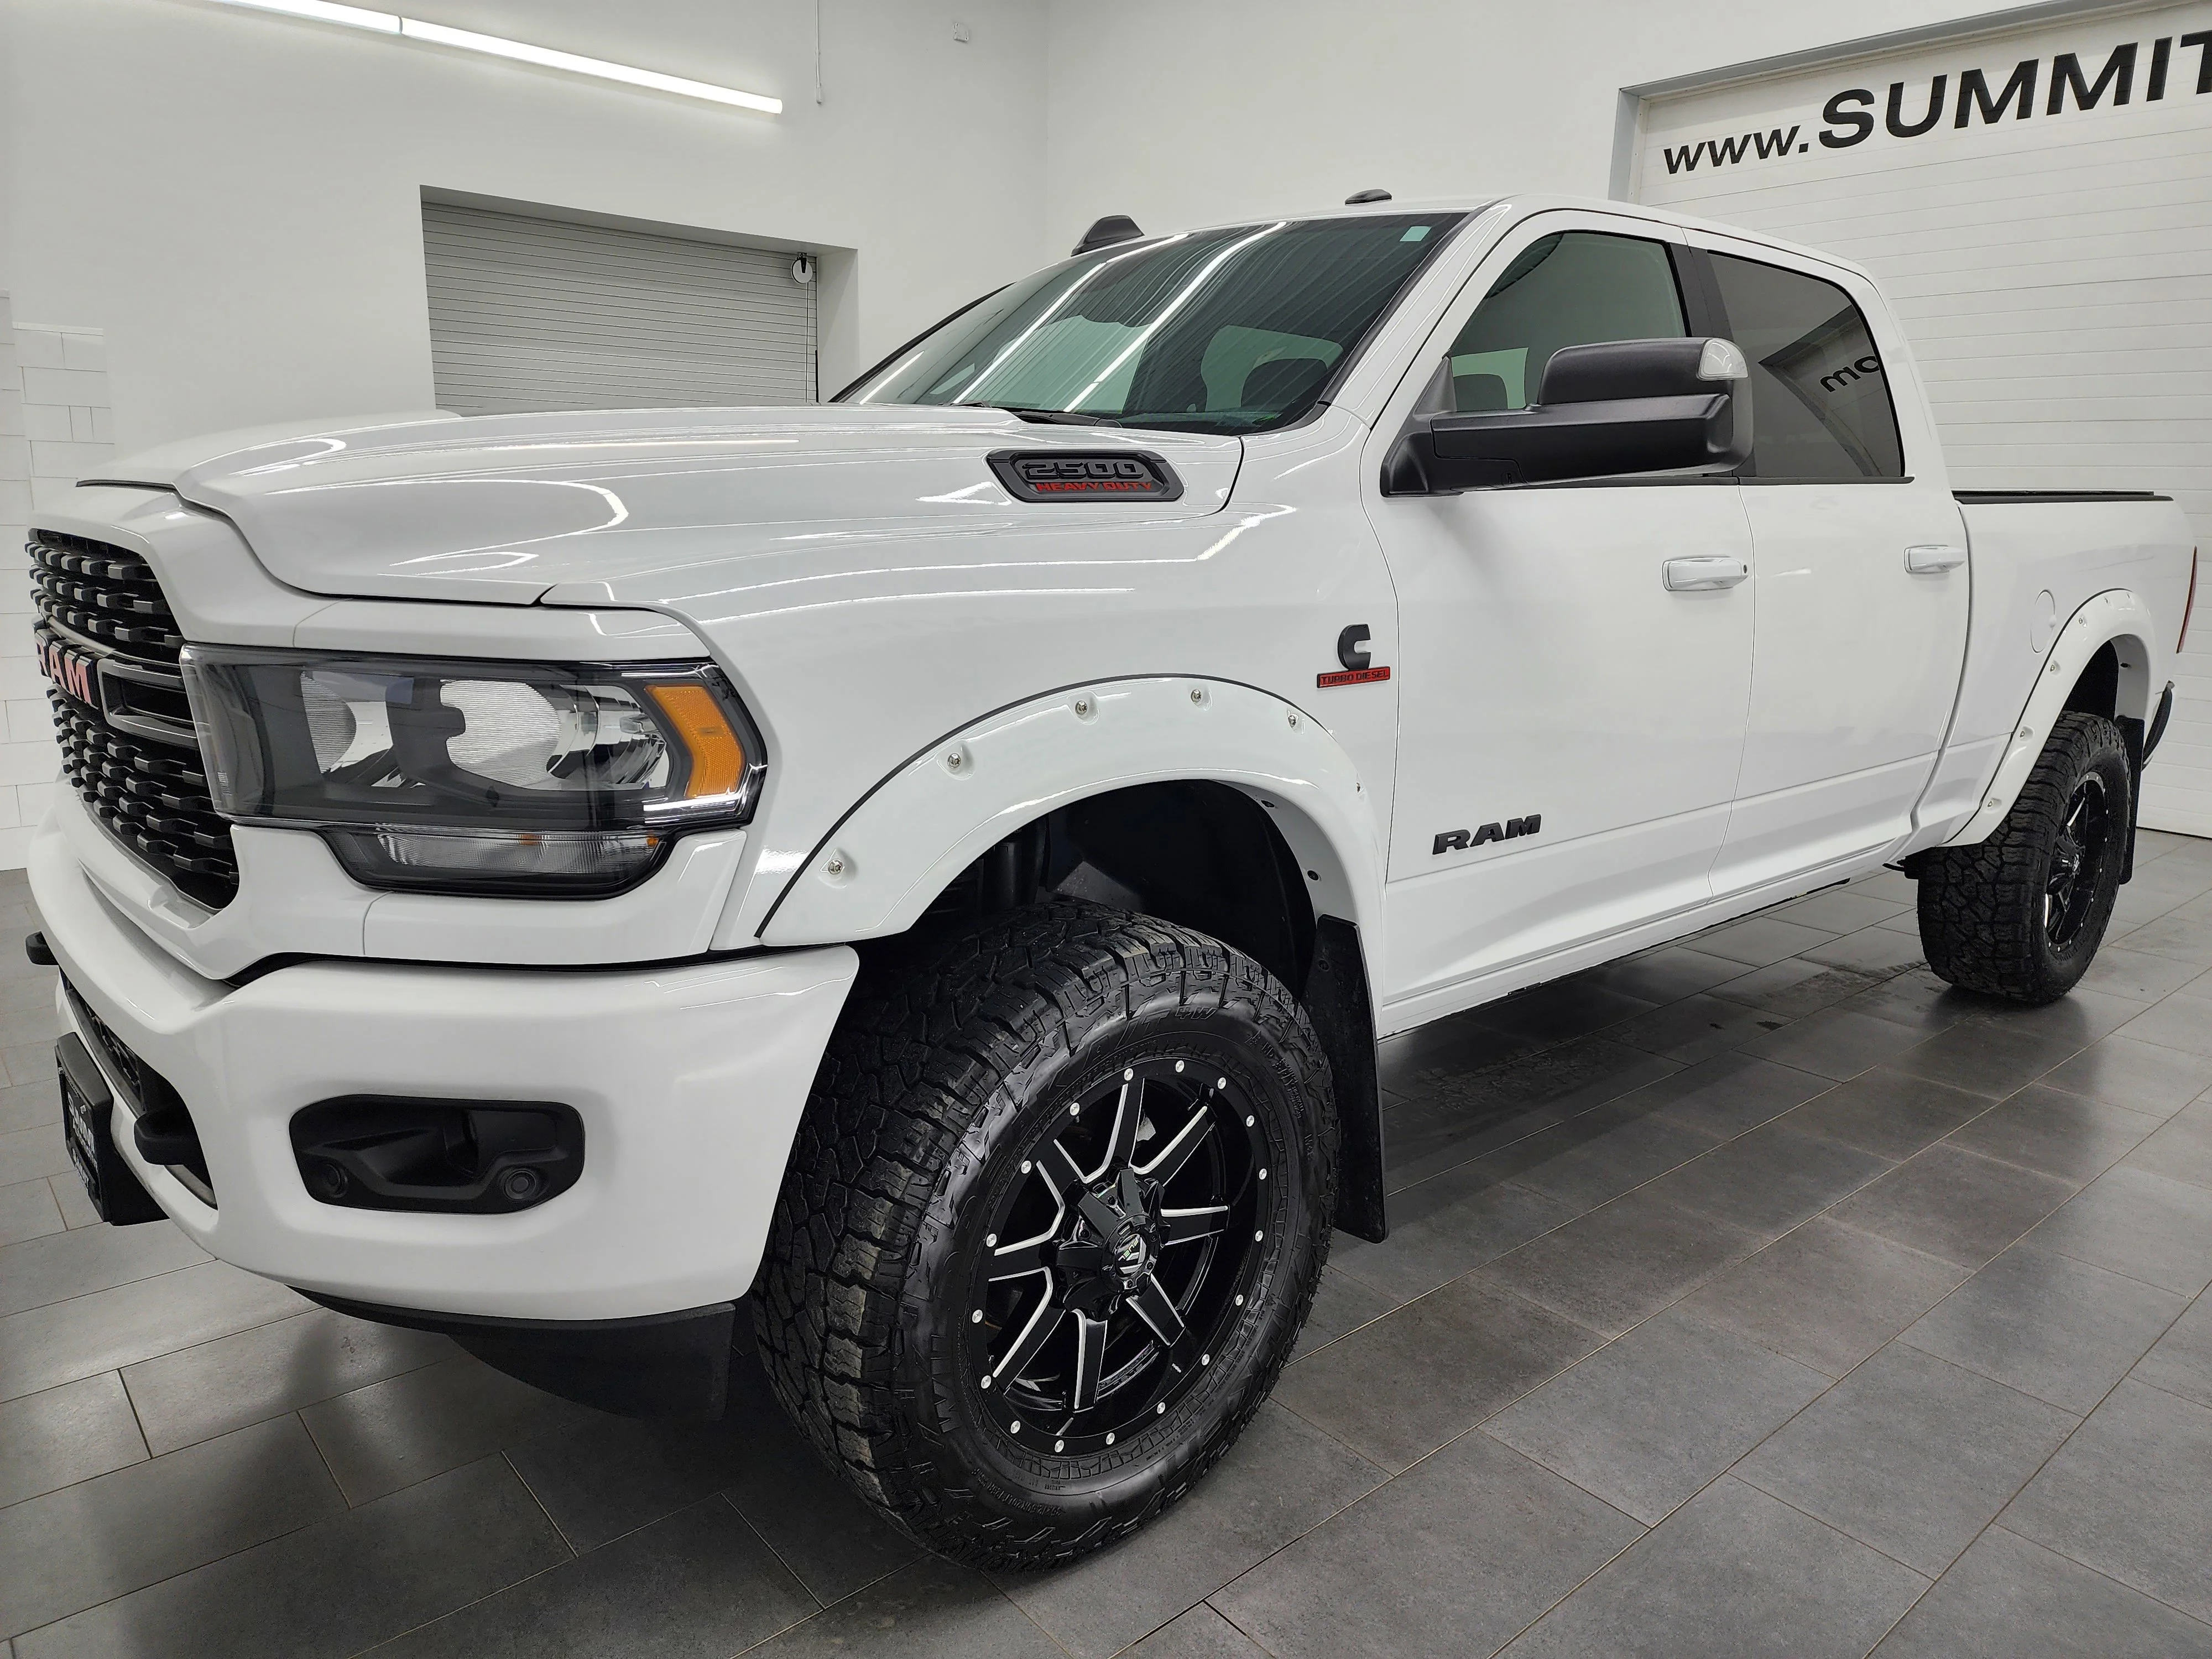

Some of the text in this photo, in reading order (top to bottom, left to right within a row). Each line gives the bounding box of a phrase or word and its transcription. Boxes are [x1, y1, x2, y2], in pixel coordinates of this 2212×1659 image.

[1022, 461, 1144, 479] 2500
[1035, 482, 1151, 492] HEAVY DUTY
[35, 632, 93, 705] RAM
[1322, 670, 1389, 685] TURBO DIESEL
[1432, 814, 1542, 855] RAM
